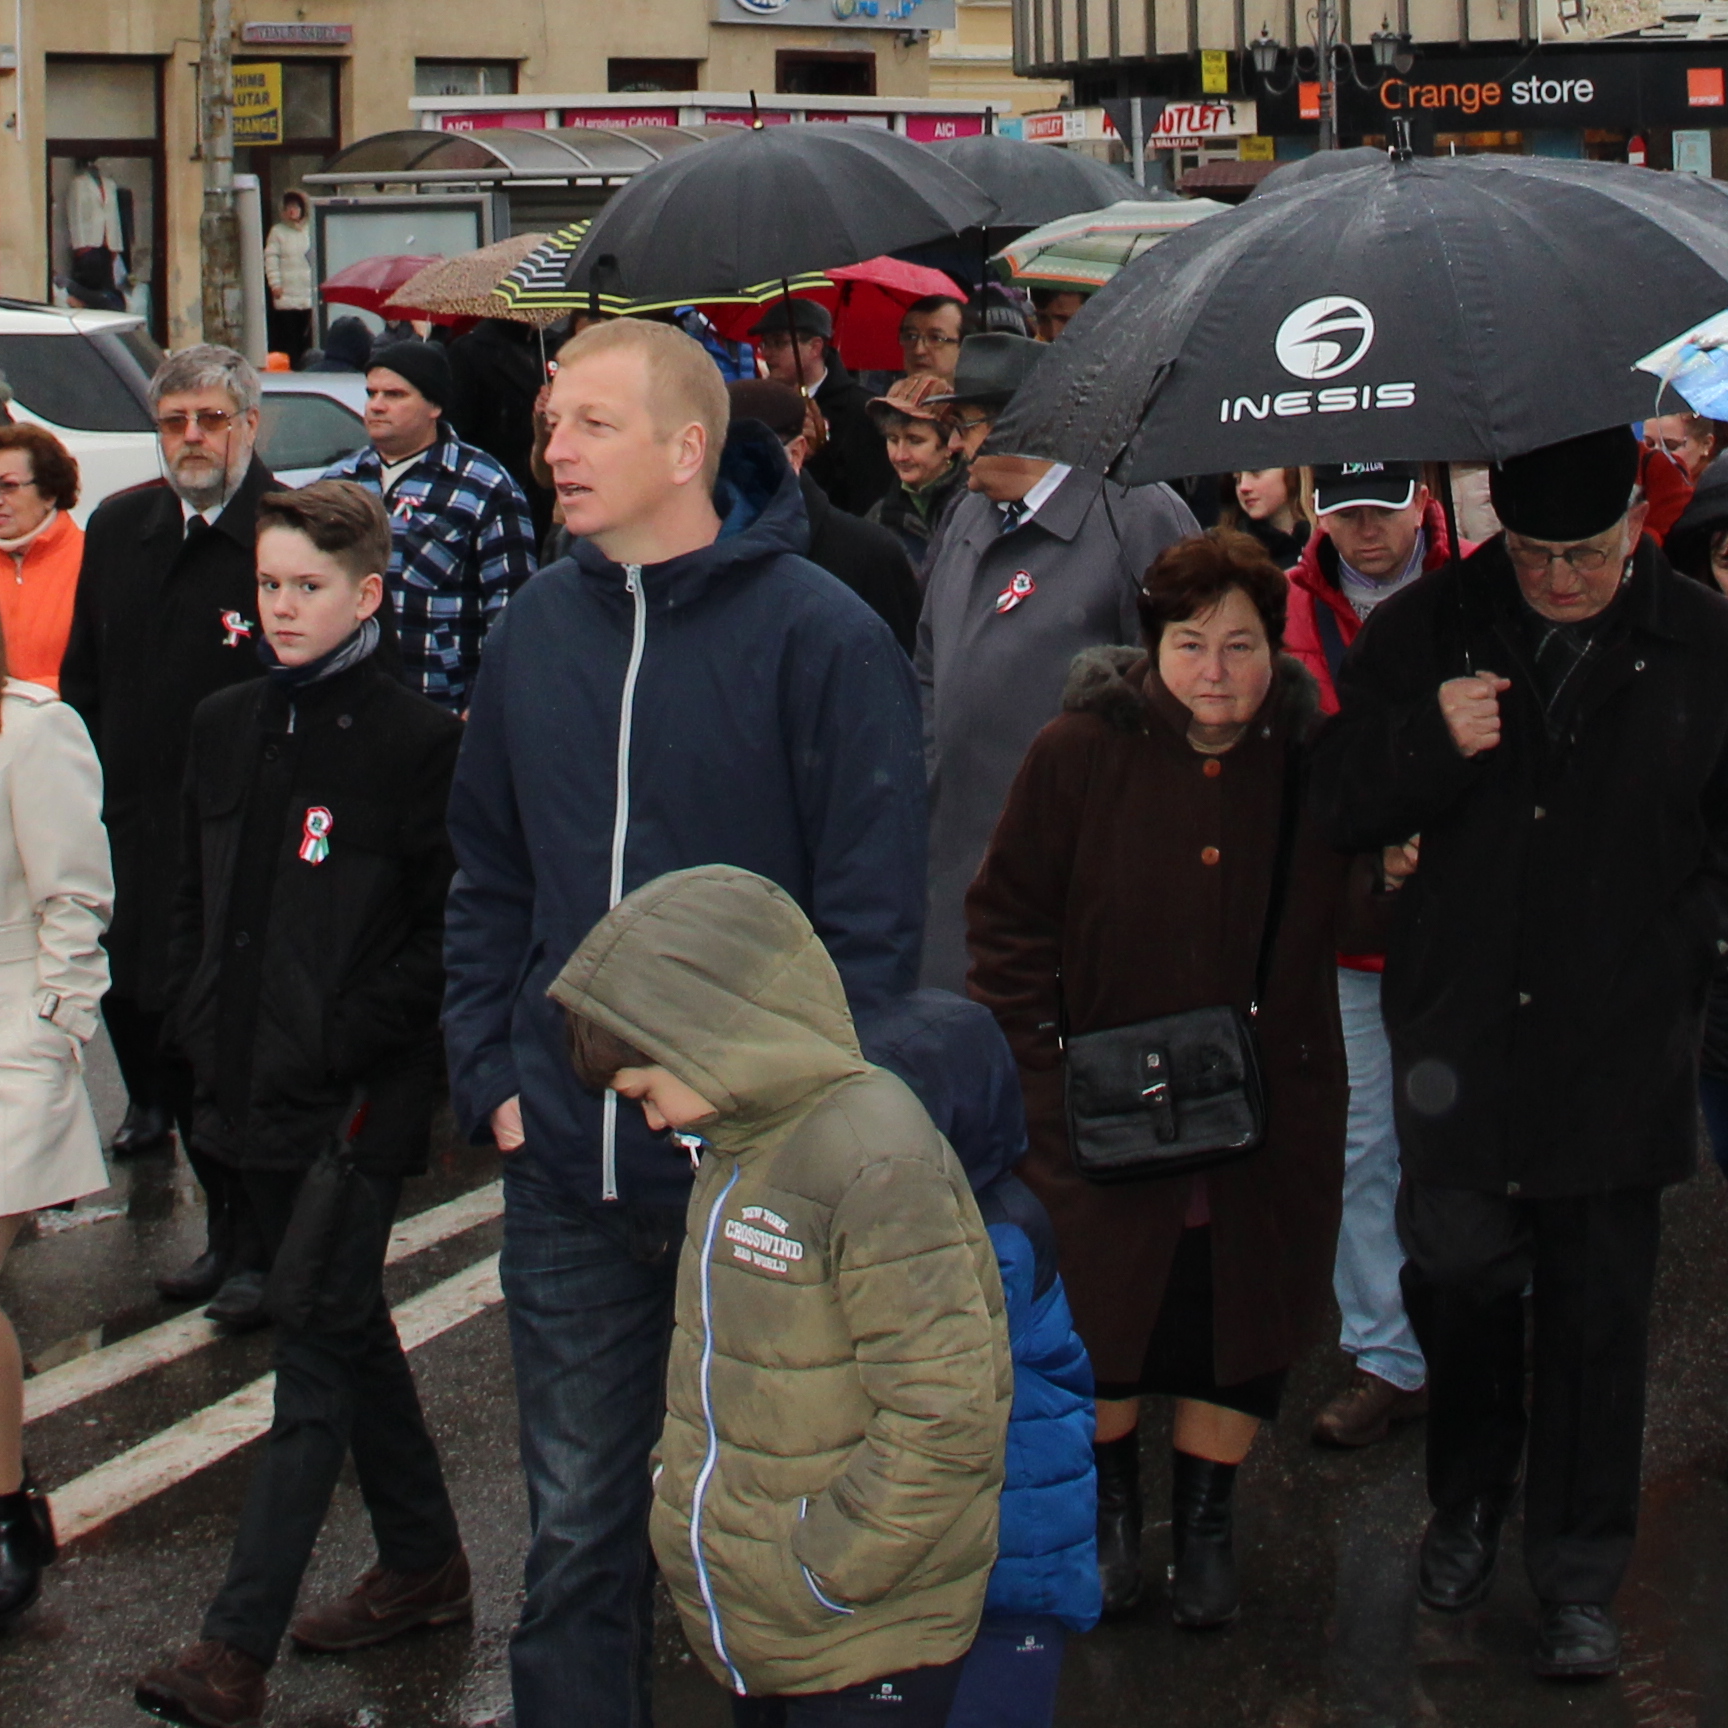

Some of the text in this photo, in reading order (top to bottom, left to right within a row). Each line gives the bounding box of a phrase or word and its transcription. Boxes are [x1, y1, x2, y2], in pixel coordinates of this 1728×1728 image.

[232, 73, 265, 88] HIMB
[1379, 75, 1595, 114] Orange store
[1689, 95, 1720, 105] orange
[934, 122, 956, 138] AICI
[1220, 382, 1417, 423] INESIS
[724, 1219, 804, 1261] CROSSWIND
